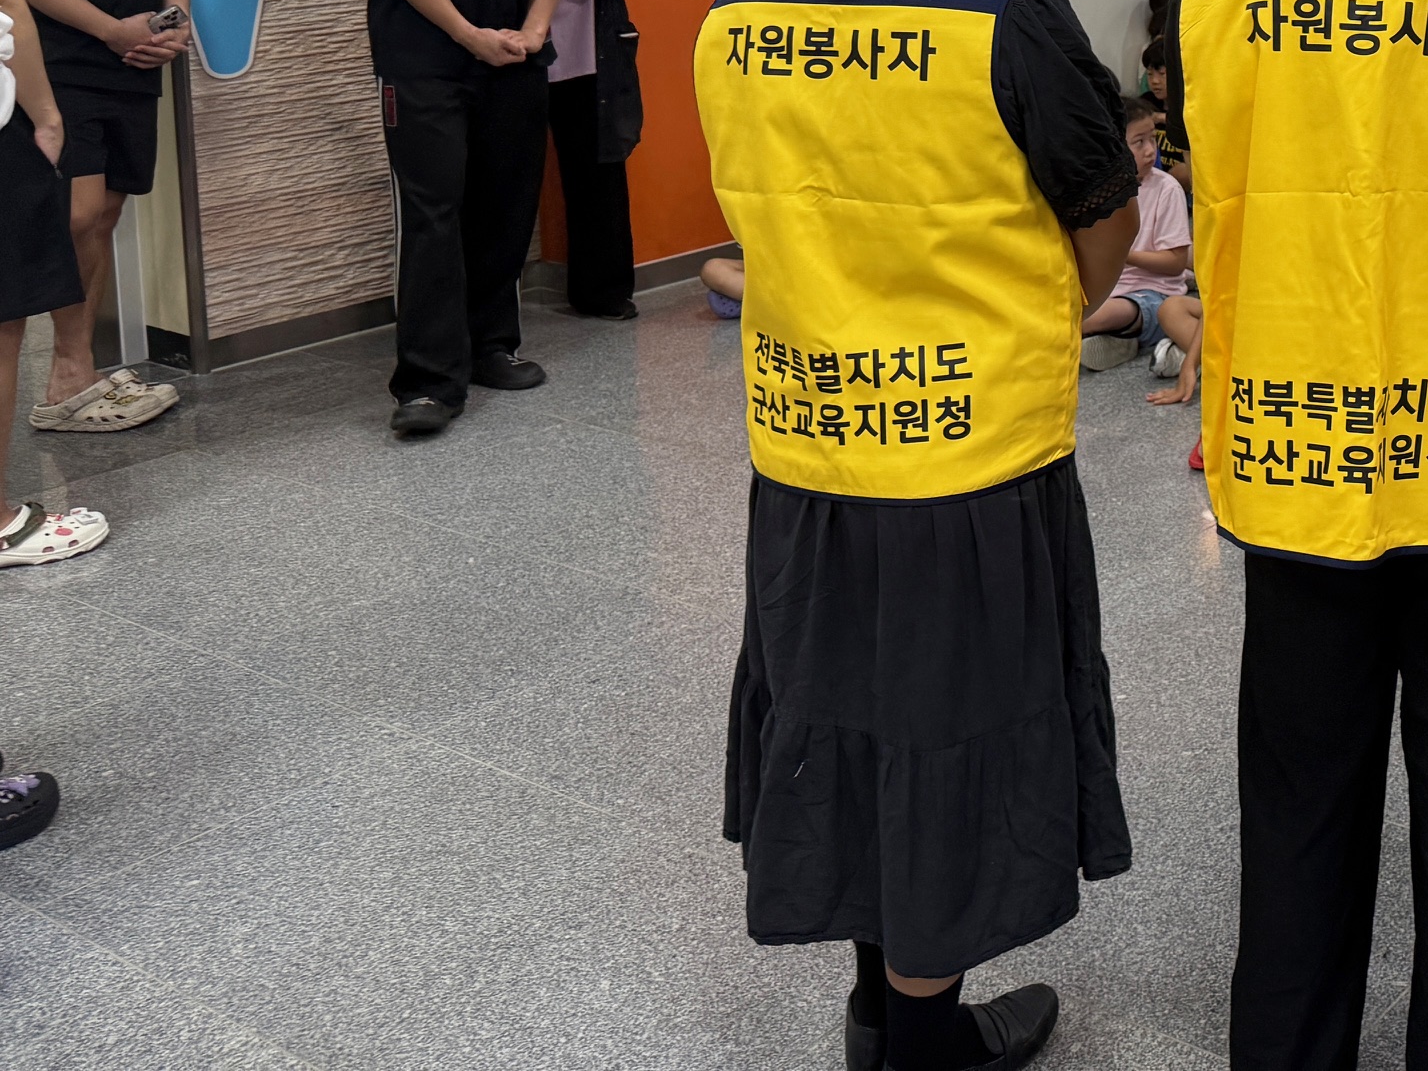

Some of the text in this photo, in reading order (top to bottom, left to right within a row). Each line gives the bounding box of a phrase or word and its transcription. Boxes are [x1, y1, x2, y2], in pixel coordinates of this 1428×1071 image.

[725, 24, 937, 82] 자원봉사자
[754, 330, 974, 395] 전북특별자치도
[752, 383, 973, 447] 군산교육지원청
